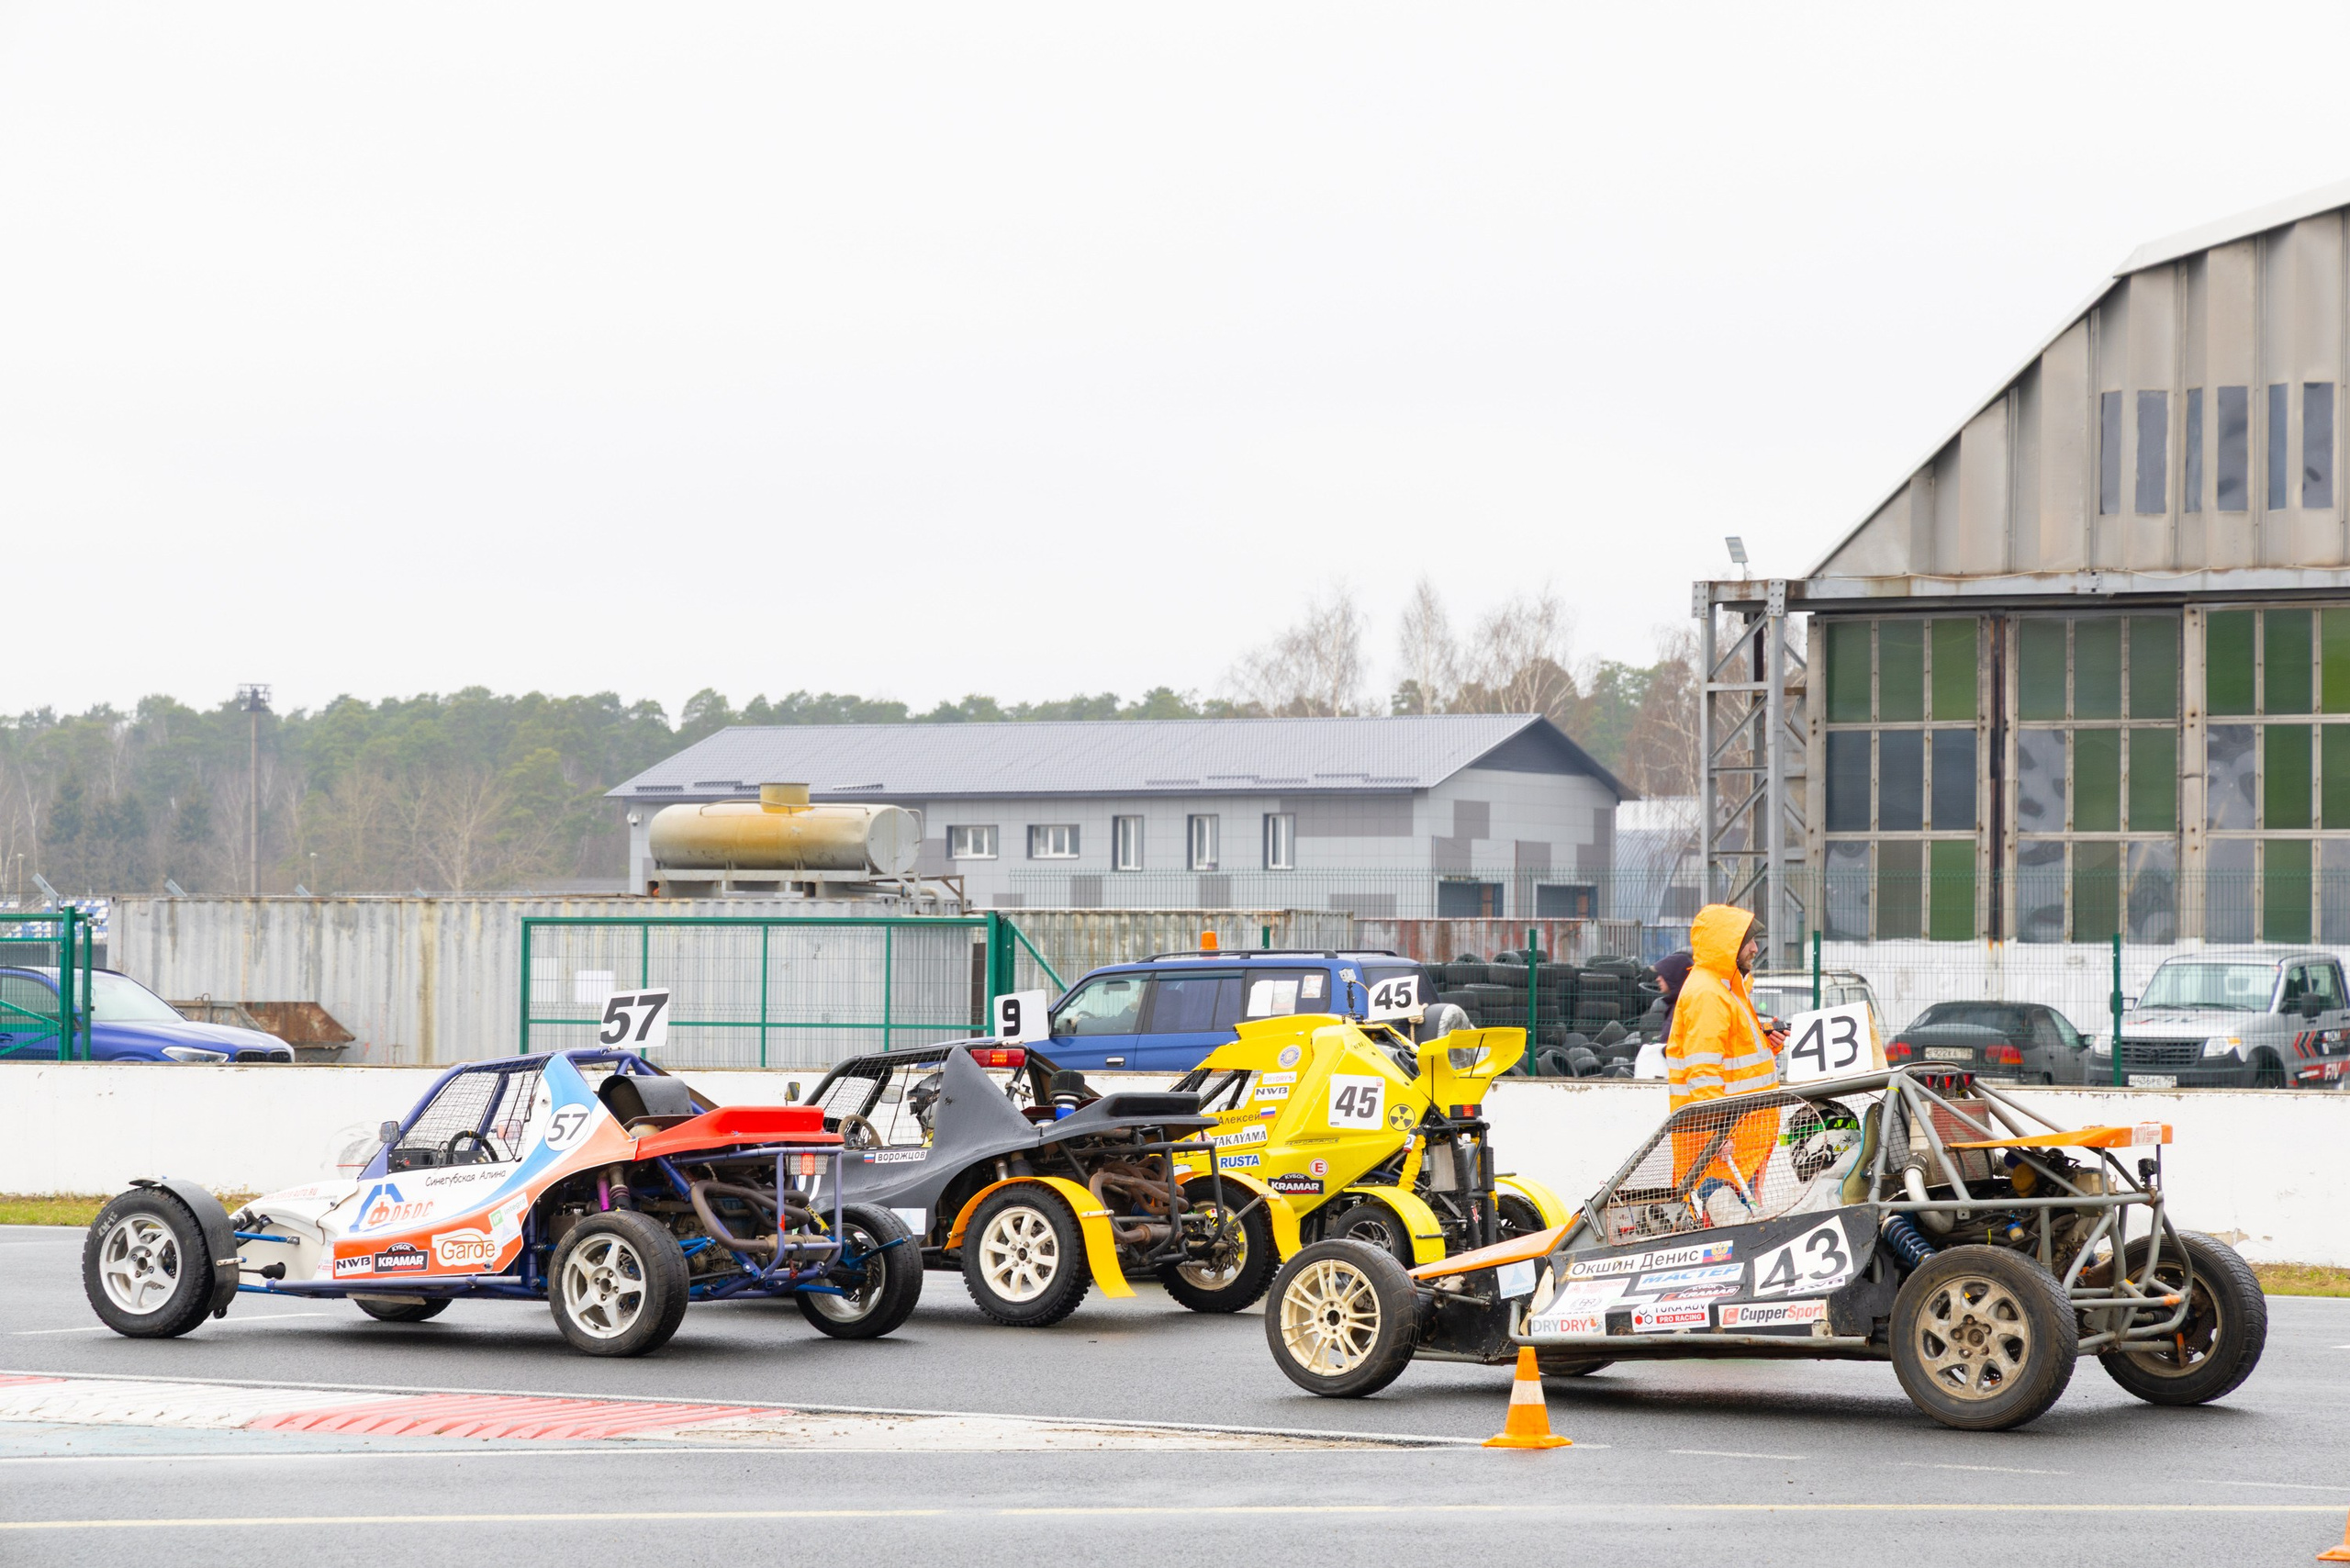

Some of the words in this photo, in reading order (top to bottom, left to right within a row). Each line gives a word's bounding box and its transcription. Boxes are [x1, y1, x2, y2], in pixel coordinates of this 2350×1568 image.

[1374, 980, 1412, 1010] 45
[599, 992, 670, 1045] 57
[1002, 999, 1021, 1037] 9
[1791, 1015, 1859, 1072] 43
[1255, 1087, 1288, 1096] NWB
[1335, 1085, 1379, 1119] 45
[547, 1113, 589, 1142] 57
[1218, 1111, 1260, 1126] Алексей
[1213, 1130, 1267, 1148] TAKAYAMA
[1220, 1155, 1260, 1169] RUSTA
[425, 1172, 476, 1188] Синегубская
[479, 1170, 507, 1181] Алина
[1270, 1182, 1319, 1192] KRAMAR
[441, 1240, 496, 1260] Garde
[1759, 1227, 1848, 1290] 43
[335, 1256, 372, 1270] NWB
[377, 1255, 425, 1267] KRAMAR
[1572, 1259, 1634, 1276] Окшин
[1639, 1249, 1699, 1271] Денис
[1641, 1264, 1741, 1284] МАСТЕР
[1678, 1288, 1737, 1299] KRAMAR
[1659, 1315, 1673, 1323] PRO
[1675, 1313, 1703, 1322] RACING
[1740, 1303, 1825, 1323] CupperSport
[1532, 1319, 1588, 1332] DRYDRY
